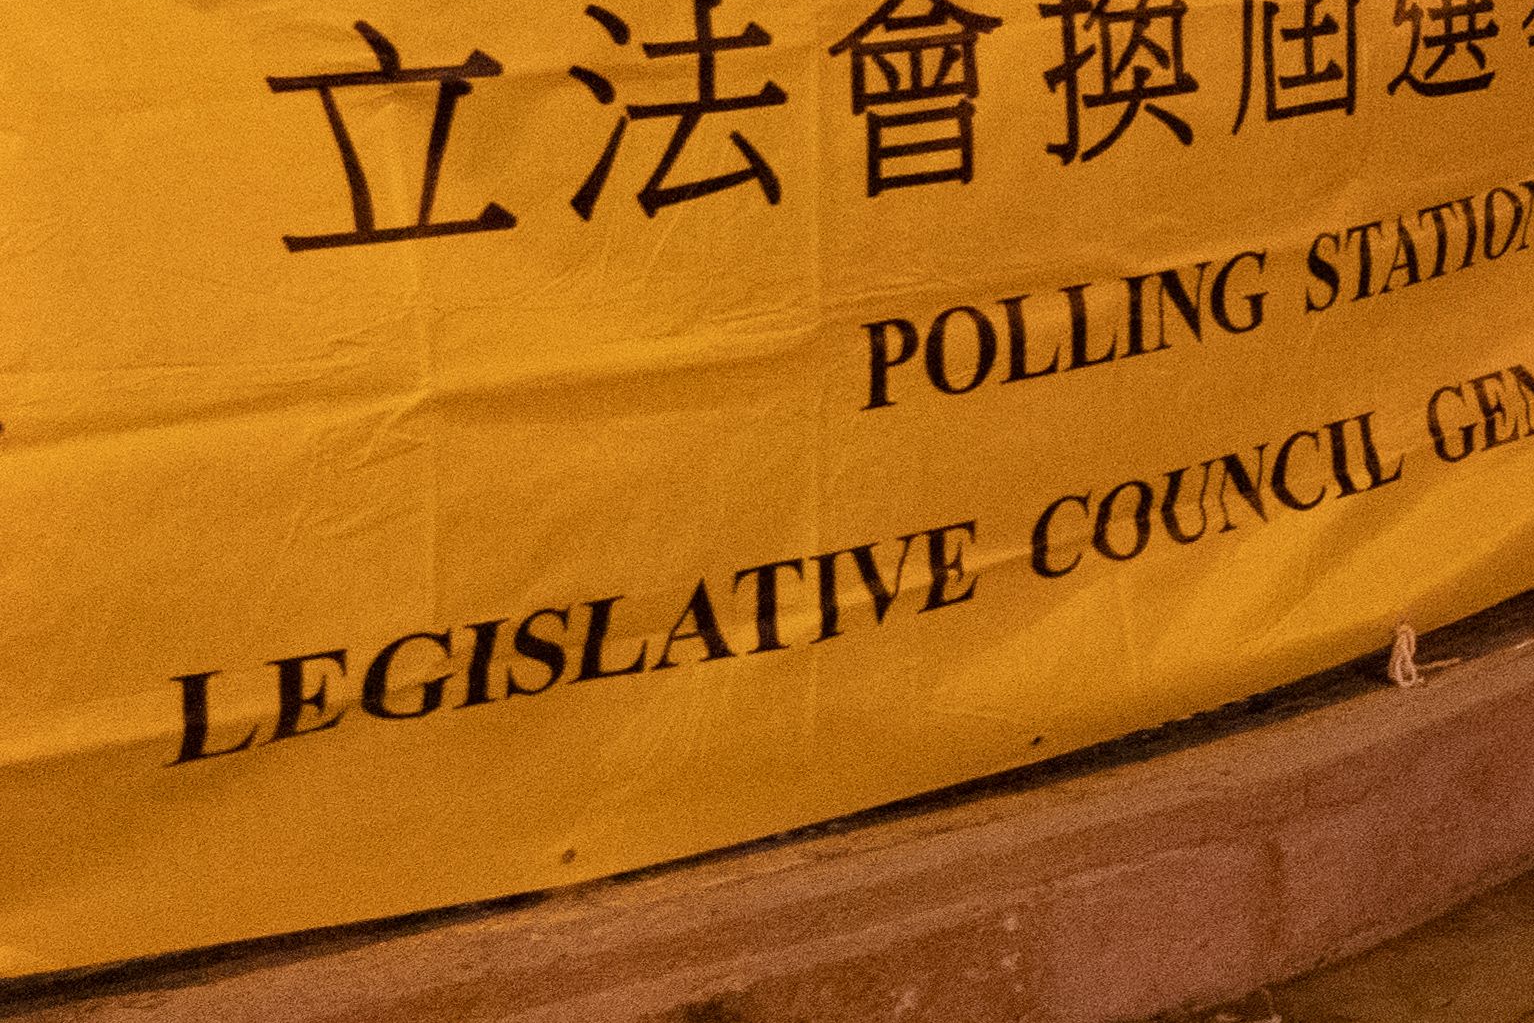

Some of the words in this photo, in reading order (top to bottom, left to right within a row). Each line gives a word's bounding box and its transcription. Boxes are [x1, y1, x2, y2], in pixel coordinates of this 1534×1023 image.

[860, 249, 1267, 411] POLLING
[163, 520, 981, 768] LEGISLATIVE
[1028, 411, 1404, 580] COUNCIL
